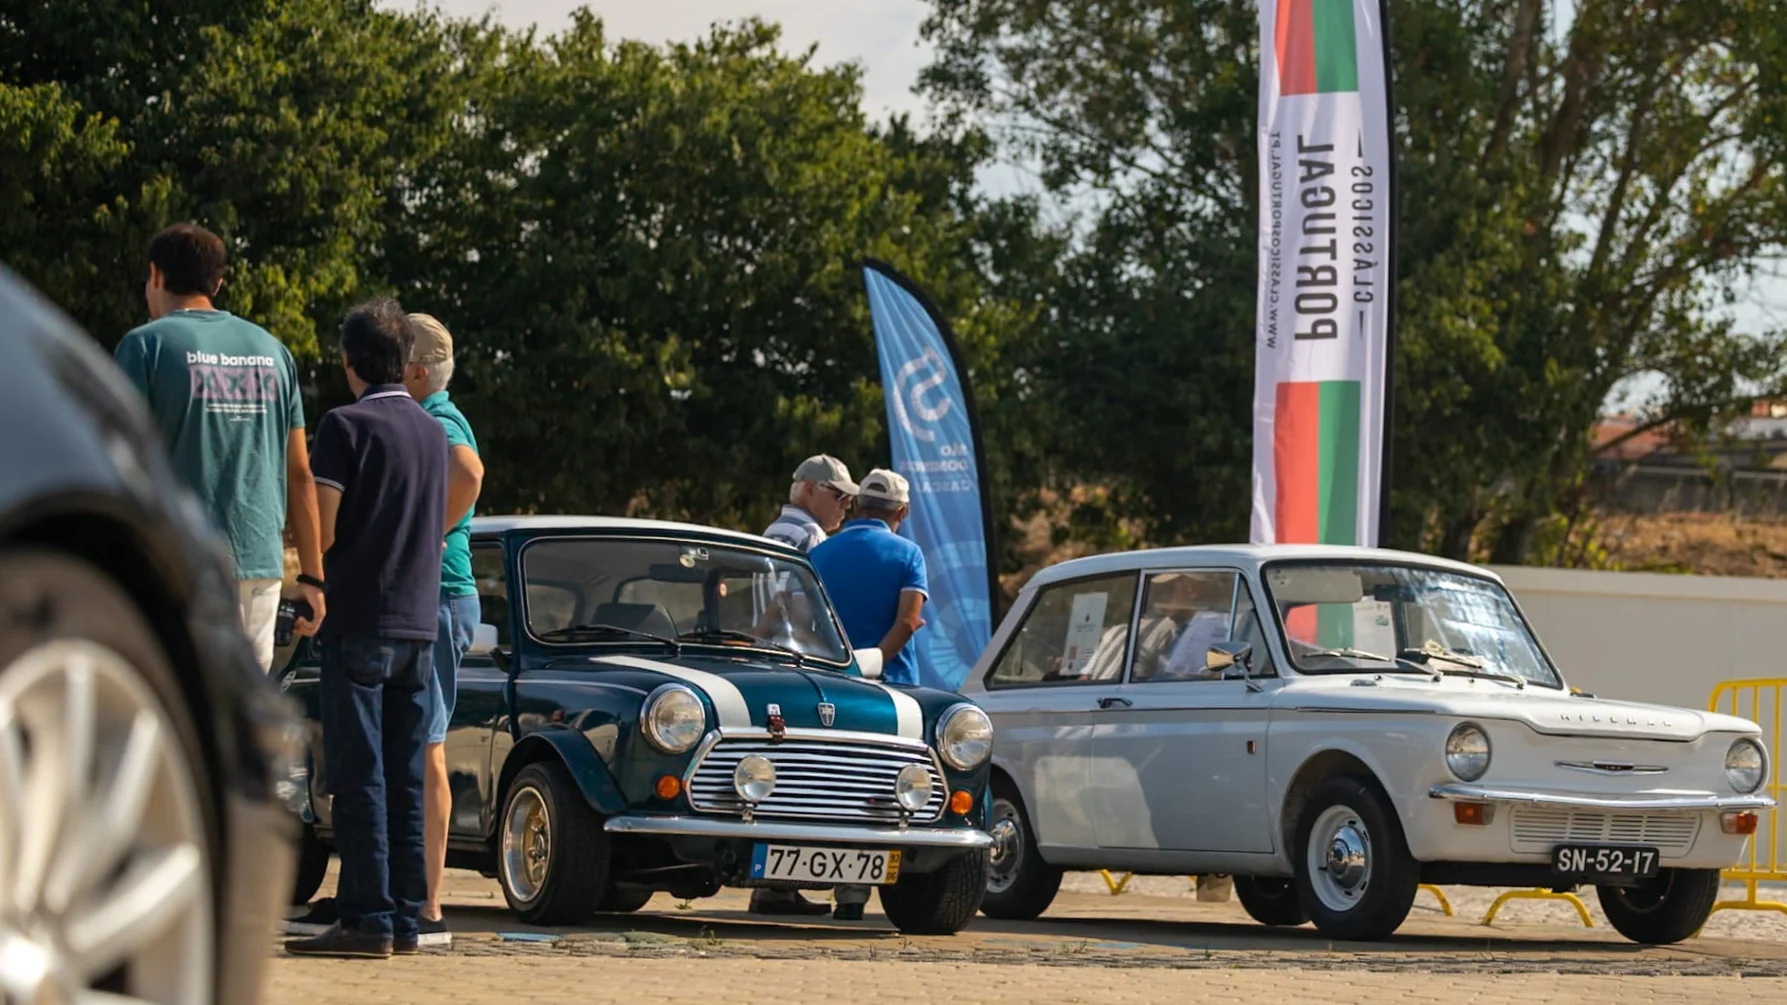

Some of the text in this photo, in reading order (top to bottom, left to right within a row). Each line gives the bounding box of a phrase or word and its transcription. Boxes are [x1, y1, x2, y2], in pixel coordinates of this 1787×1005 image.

[186, 351, 274, 367] blue banana
[1557, 848, 1655, 874] SN-52-17
